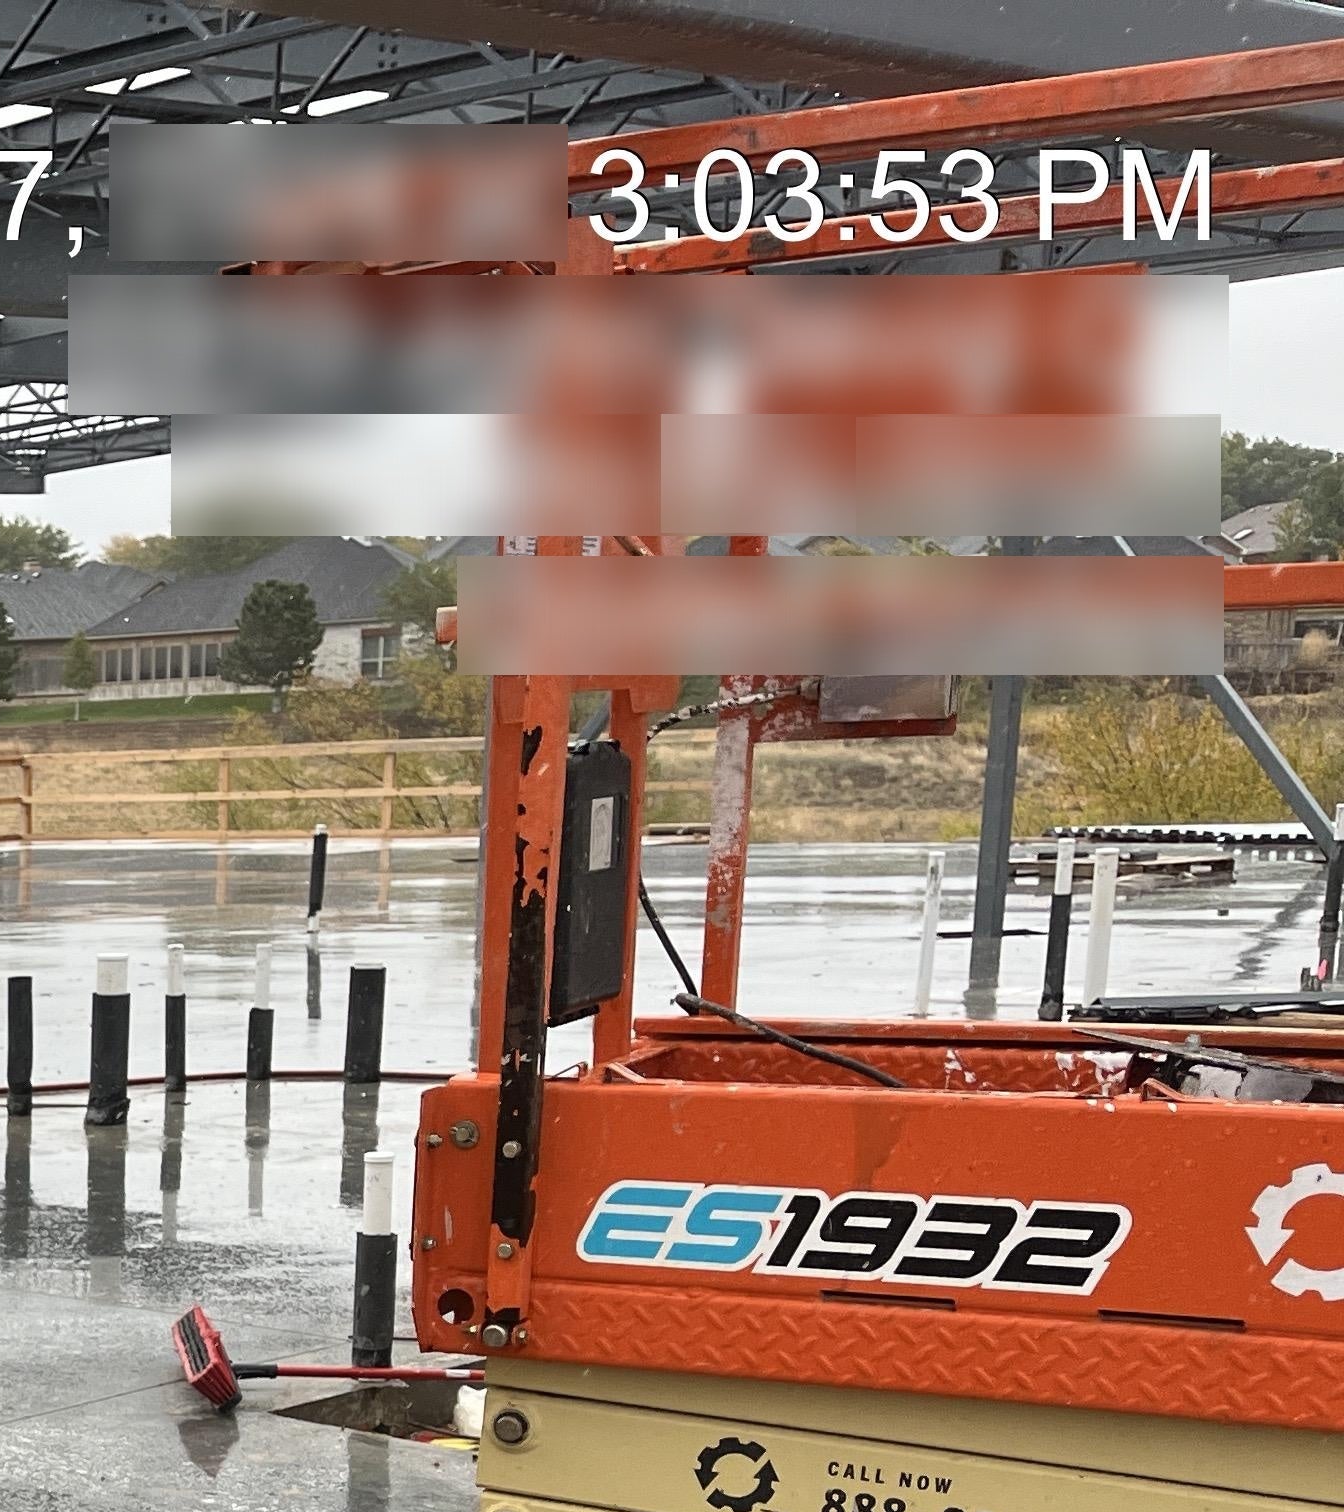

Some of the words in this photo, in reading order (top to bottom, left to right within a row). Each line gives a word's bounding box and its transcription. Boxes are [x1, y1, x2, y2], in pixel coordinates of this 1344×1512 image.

[580, 1185, 1126, 1290] ES1932
[827, 1461, 886, 1485] CALL
[898, 1471, 953, 1495] NOW
